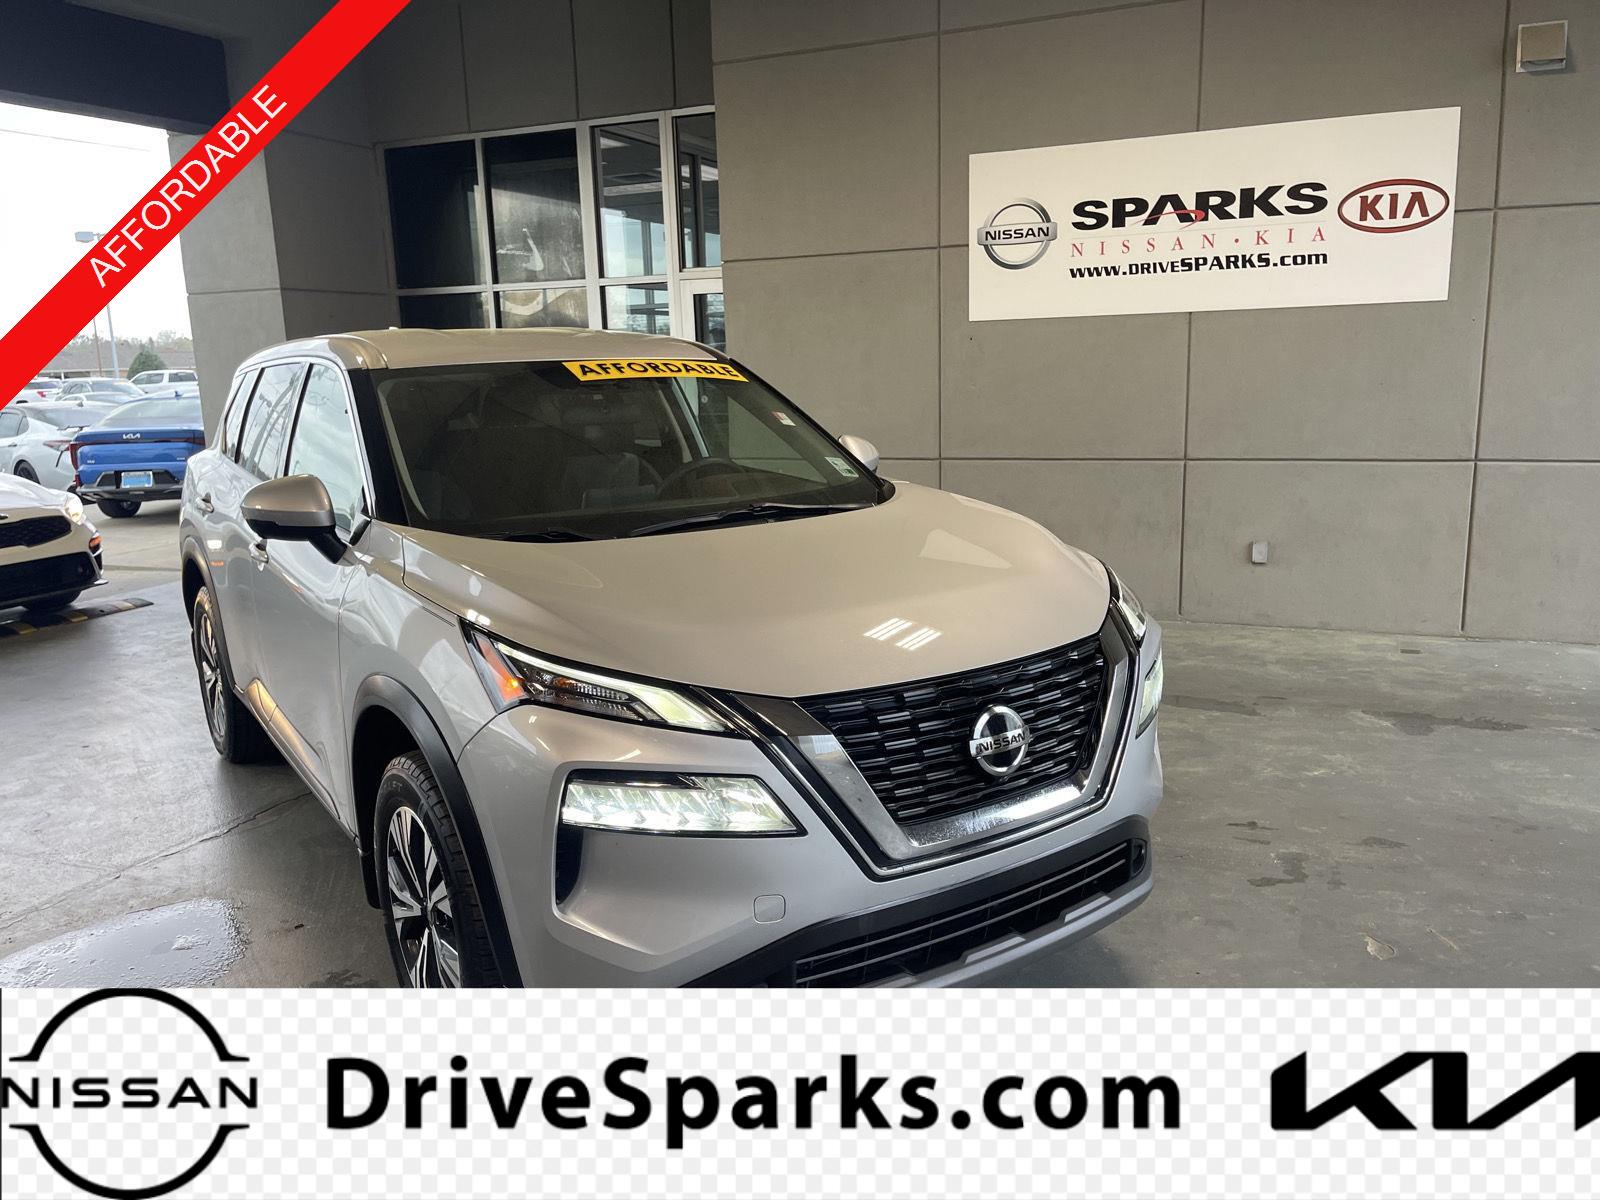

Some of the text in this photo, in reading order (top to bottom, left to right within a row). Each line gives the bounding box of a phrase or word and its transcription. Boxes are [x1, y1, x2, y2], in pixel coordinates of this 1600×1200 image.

[1071, 182, 1328, 231] SPARKS
[1359, 191, 1430, 222] KIA
[984, 226, 1050, 242] NISSAN
[1071, 225, 1327, 258] NISSAN KIA
[578, 361, 740, 378] AFFORDABLE
[976, 732, 1025, 754] NISSAN
